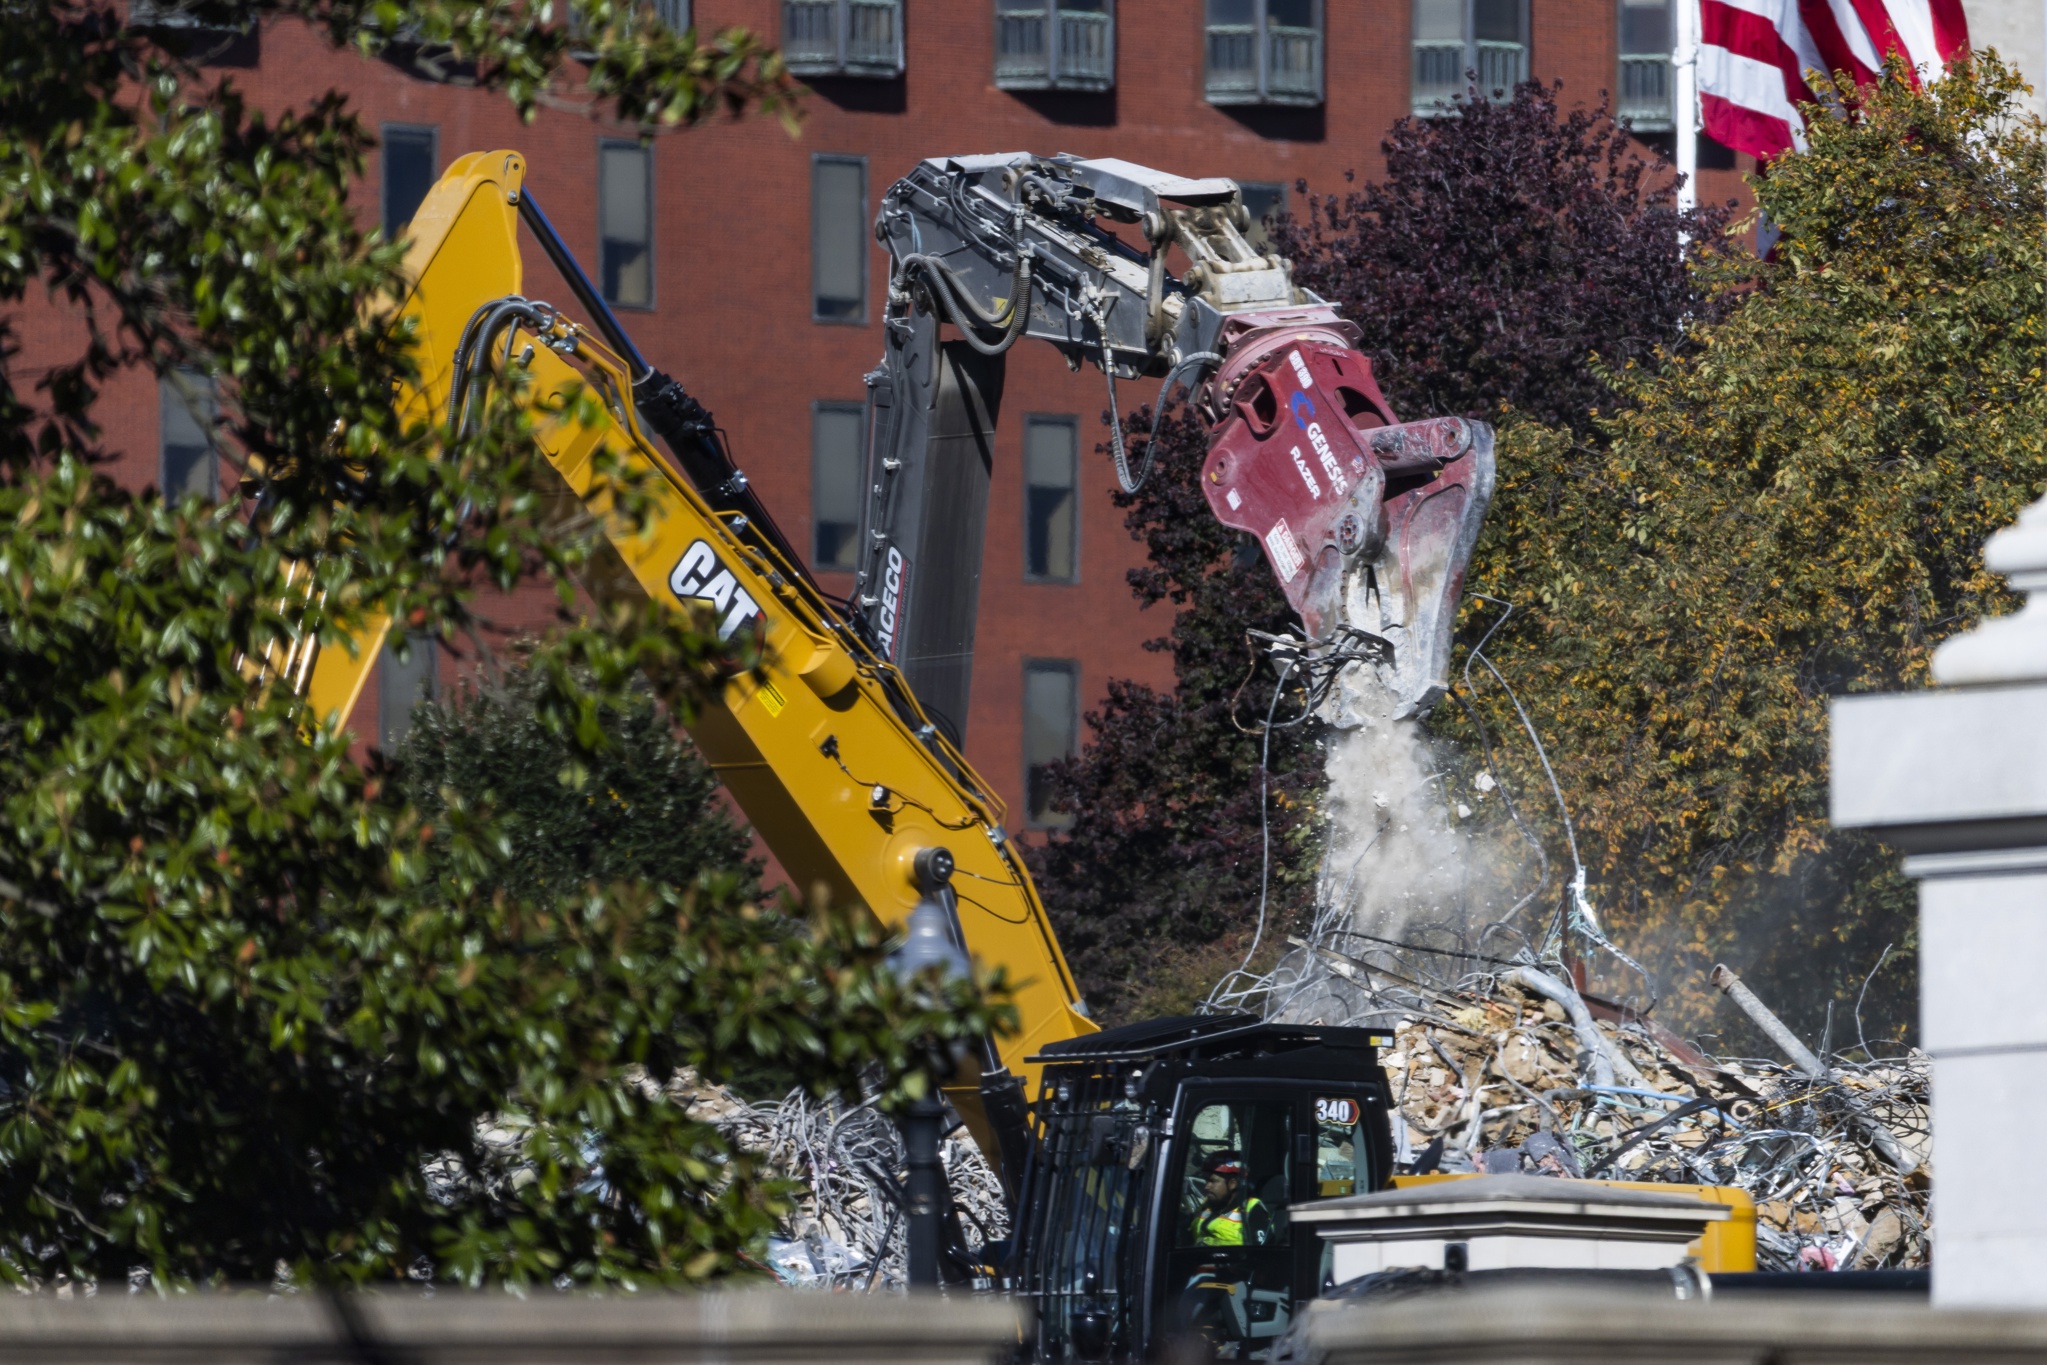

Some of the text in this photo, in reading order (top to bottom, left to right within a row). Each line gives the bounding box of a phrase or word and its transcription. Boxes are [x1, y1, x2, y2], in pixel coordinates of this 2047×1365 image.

[1290, 445, 1321, 500] RAZER
[1308, 422, 1348, 495] GENESIS
[1281, 530, 1302, 567] DANGER
[671, 539, 760, 642] CAT
[878, 546, 902, 658] ACECO
[901, 562, 911, 614] DEMOLITION
[1316, 1099, 1349, 1122] 340
